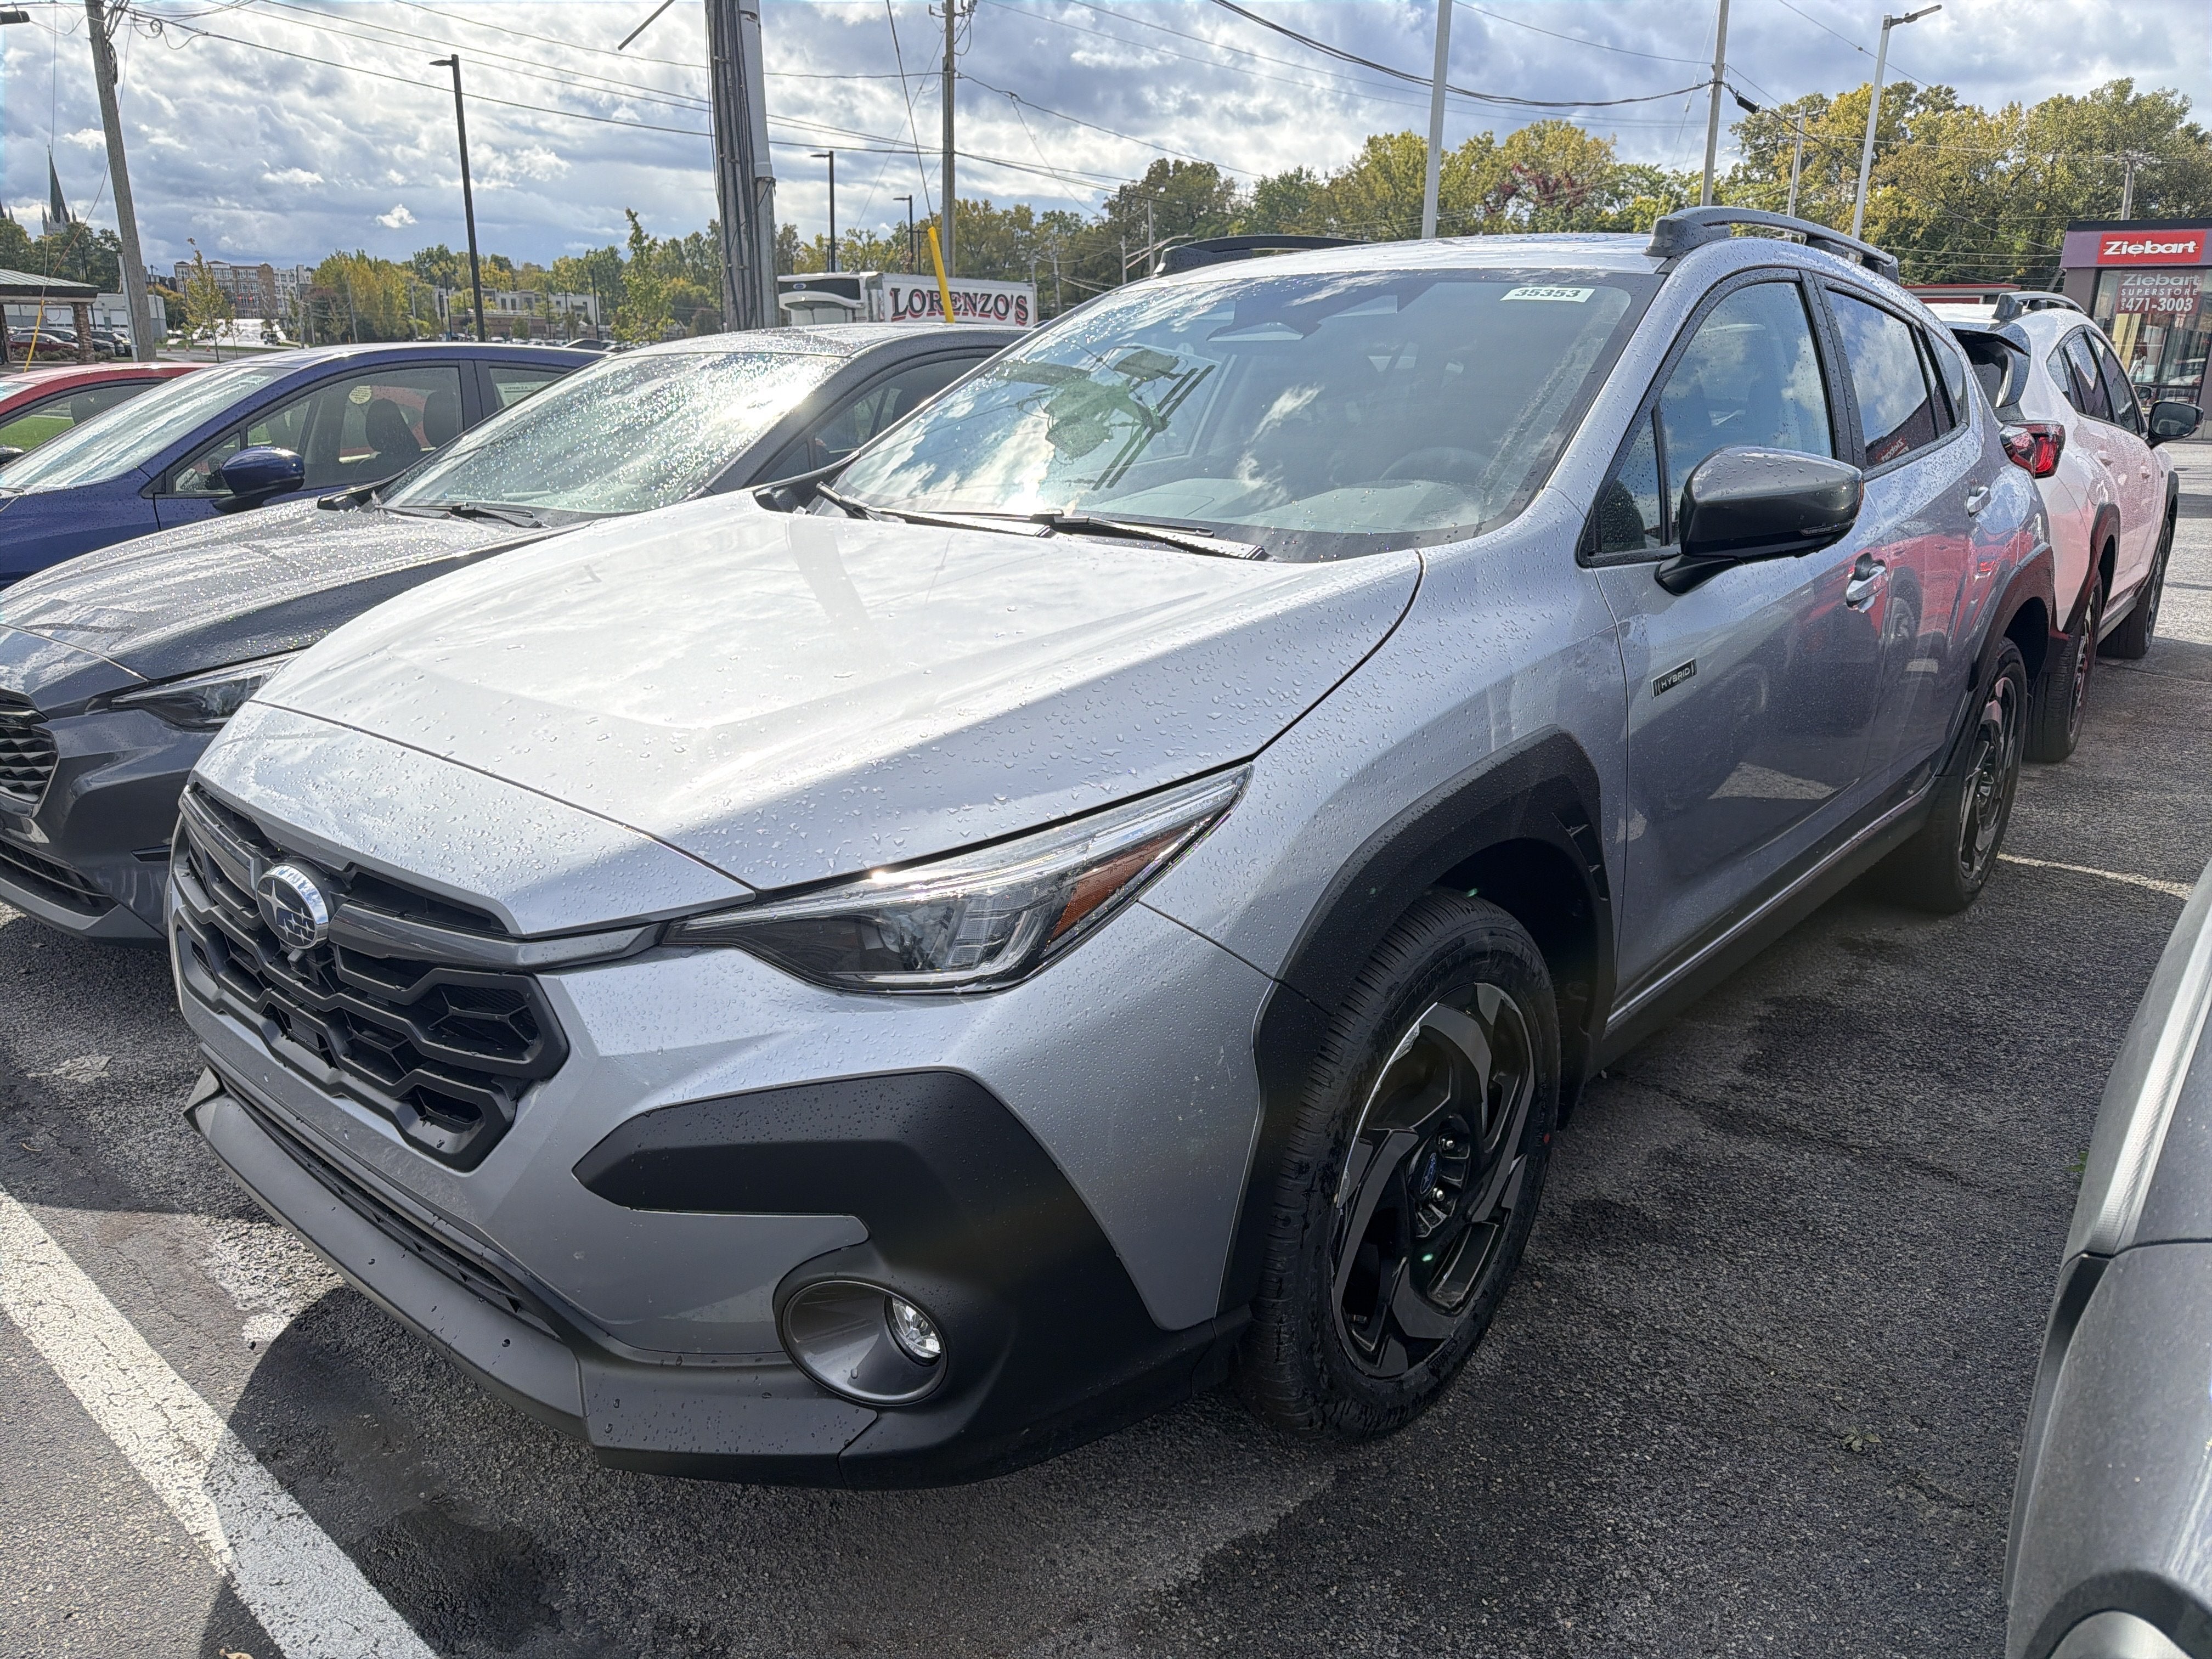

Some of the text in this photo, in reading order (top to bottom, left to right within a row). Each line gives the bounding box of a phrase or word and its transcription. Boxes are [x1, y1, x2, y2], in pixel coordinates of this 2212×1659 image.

[2103, 240, 2197, 255] Ziebart
[2121, 273, 2200, 286] Ziebart
[1514, 289, 1582, 297] 35353
[2121, 288, 2199, 296] SUPERSTORE
[889, 287, 1030, 326] LORENZO'S
[2125, 297, 2194, 312] 471-3003
[1661, 668, 1691, 689] HYBRID
